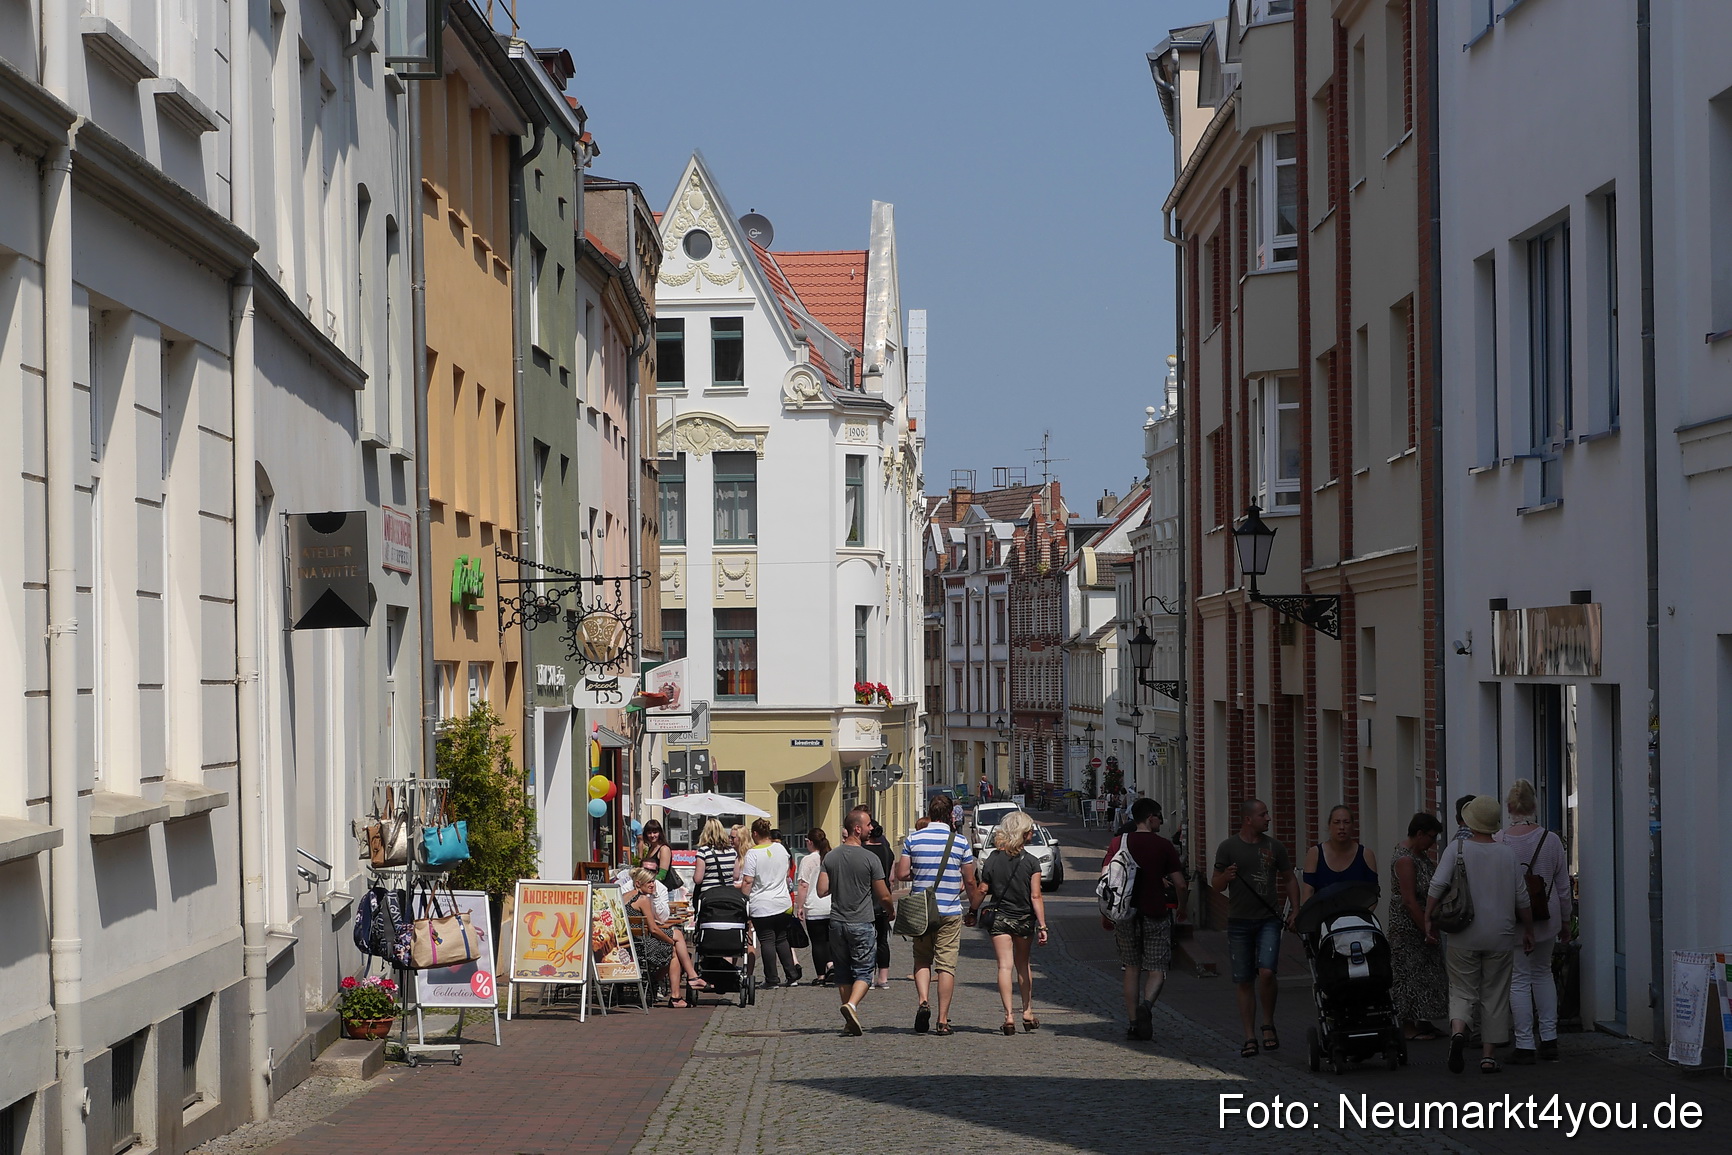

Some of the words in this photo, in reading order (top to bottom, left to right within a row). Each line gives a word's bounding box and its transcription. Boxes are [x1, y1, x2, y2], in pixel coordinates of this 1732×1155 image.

[849, 427, 866, 437] 1906
[303, 545, 353, 558] ATELIER
[321, 565, 358, 579] WITTE
[523, 887, 584, 906] ÄNDERUNGEN
[432, 985, 475, 997] Collection
[475, 974, 491, 996] %
